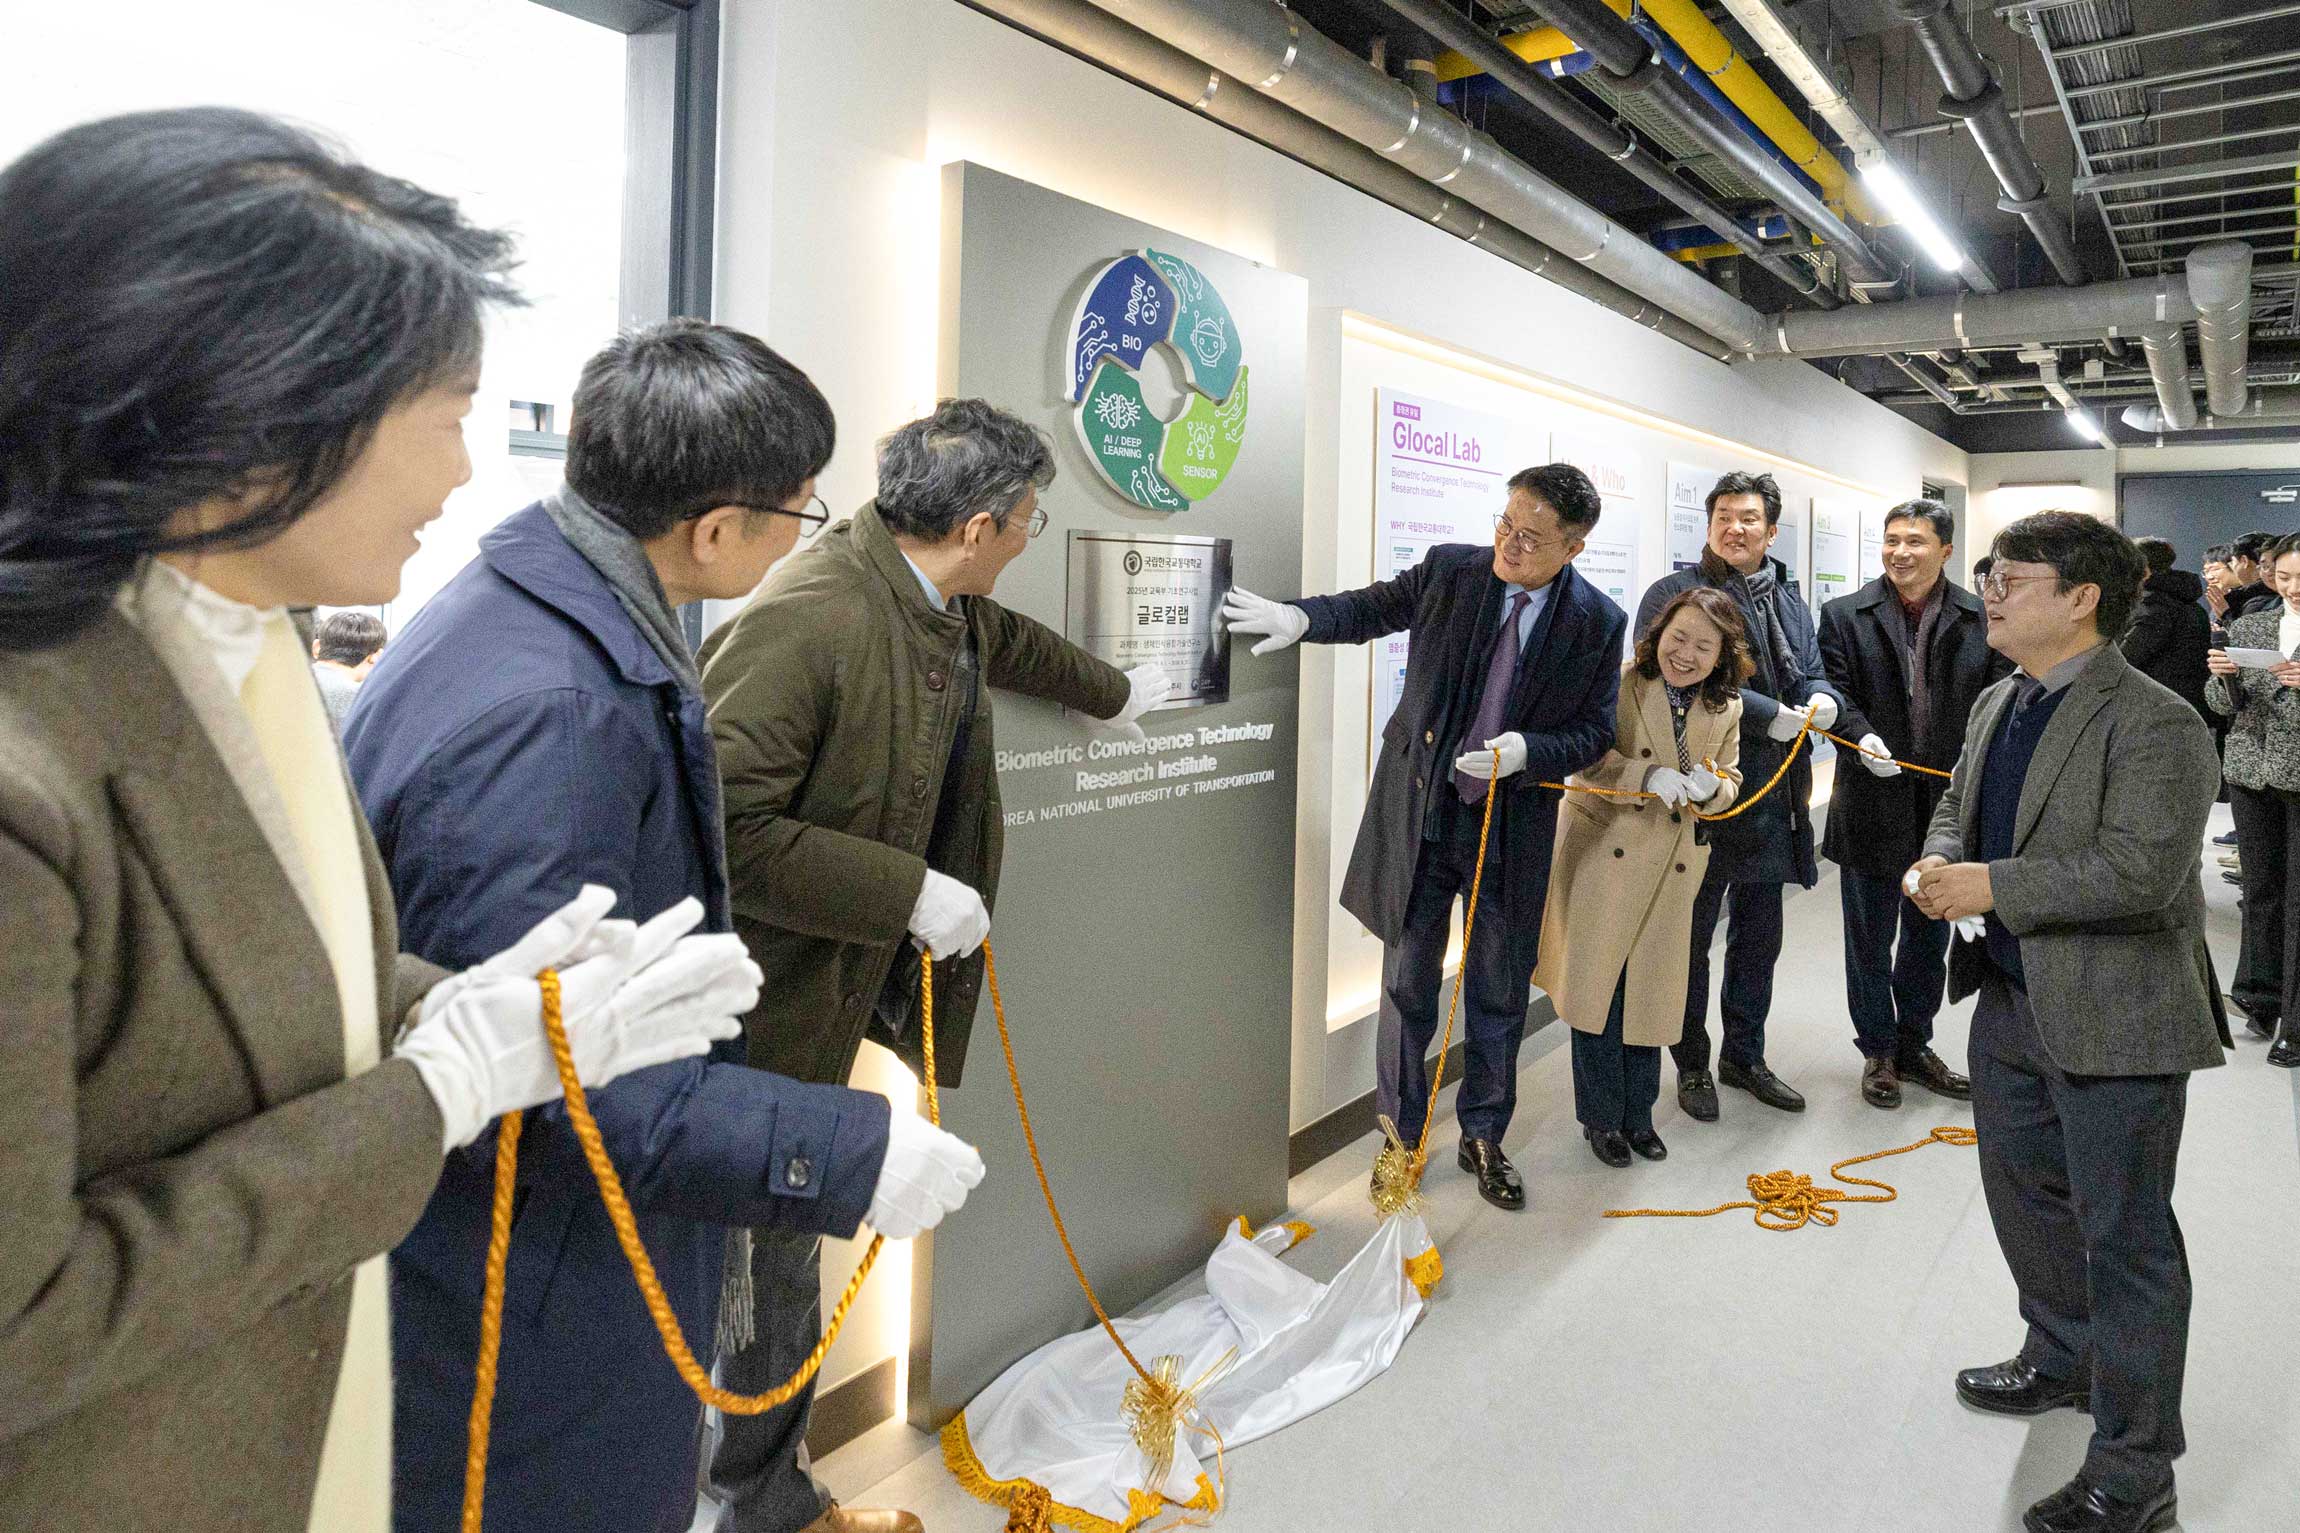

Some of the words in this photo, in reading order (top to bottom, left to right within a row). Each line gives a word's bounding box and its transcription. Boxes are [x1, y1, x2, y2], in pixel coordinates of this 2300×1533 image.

[1122, 334, 1142, 351] BIO
[1104, 434, 1113, 444] AI
[1121, 436, 1142, 447] DEEP
[1393, 421, 1448, 458] Glocal
[1453, 432, 1481, 464] Lab
[1104, 445, 1142, 459] LEARNING
[1183, 464, 1217, 480] SENSOR
[1391, 466, 1420, 481] Biometric
[1601, 465, 1626, 491] Who
[1391, 482, 1419, 496] Research
[1674, 482, 1692, 503] Aim
[1692, 486, 1697, 504] 1
[1390, 520, 1405, 530] WHY
[1144, 556, 1202, 569] 국립한국교통대학교
[1137, 605, 1189, 625] 글로컬랩
[996, 745, 1083, 772] Biometric
[1088, 733, 1194, 760] Convergence
[1198, 722, 1274, 745] Technology
[1076, 767, 1154, 792] Research
[1159, 755, 1217, 779] Institute
[1040, 800, 1102, 821] NATIONAL
[1107, 789, 1172, 810] UNIVERSITY
[1176, 784, 1190, 798] OF
[1194, 770, 1275, 792] TRANSPORTATION
